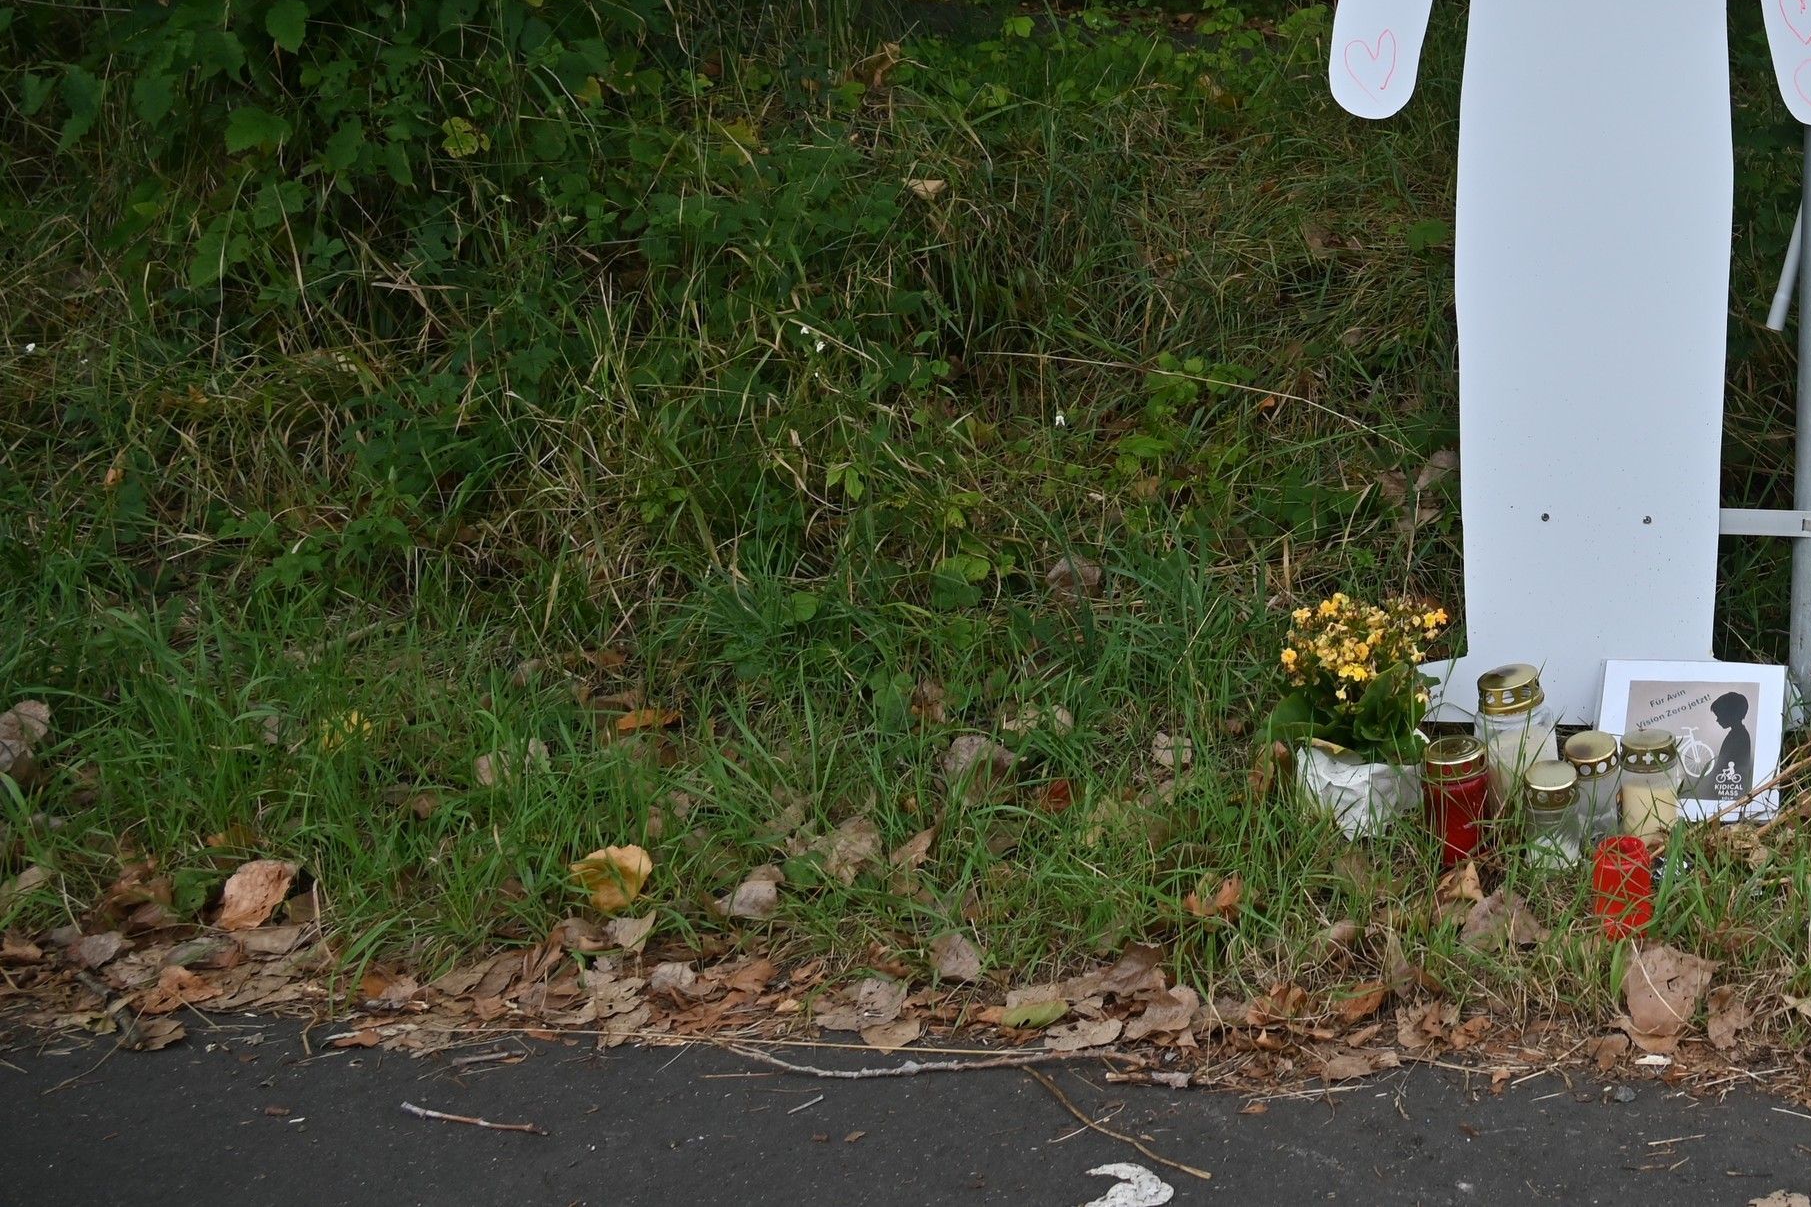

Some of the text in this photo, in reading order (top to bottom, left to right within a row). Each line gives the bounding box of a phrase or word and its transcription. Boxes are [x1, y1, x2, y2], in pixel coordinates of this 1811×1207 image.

[1649, 689, 1687, 708] Für Avin
[1636, 714, 1665, 729] Vision
[1666, 705, 1687, 717] Zero
